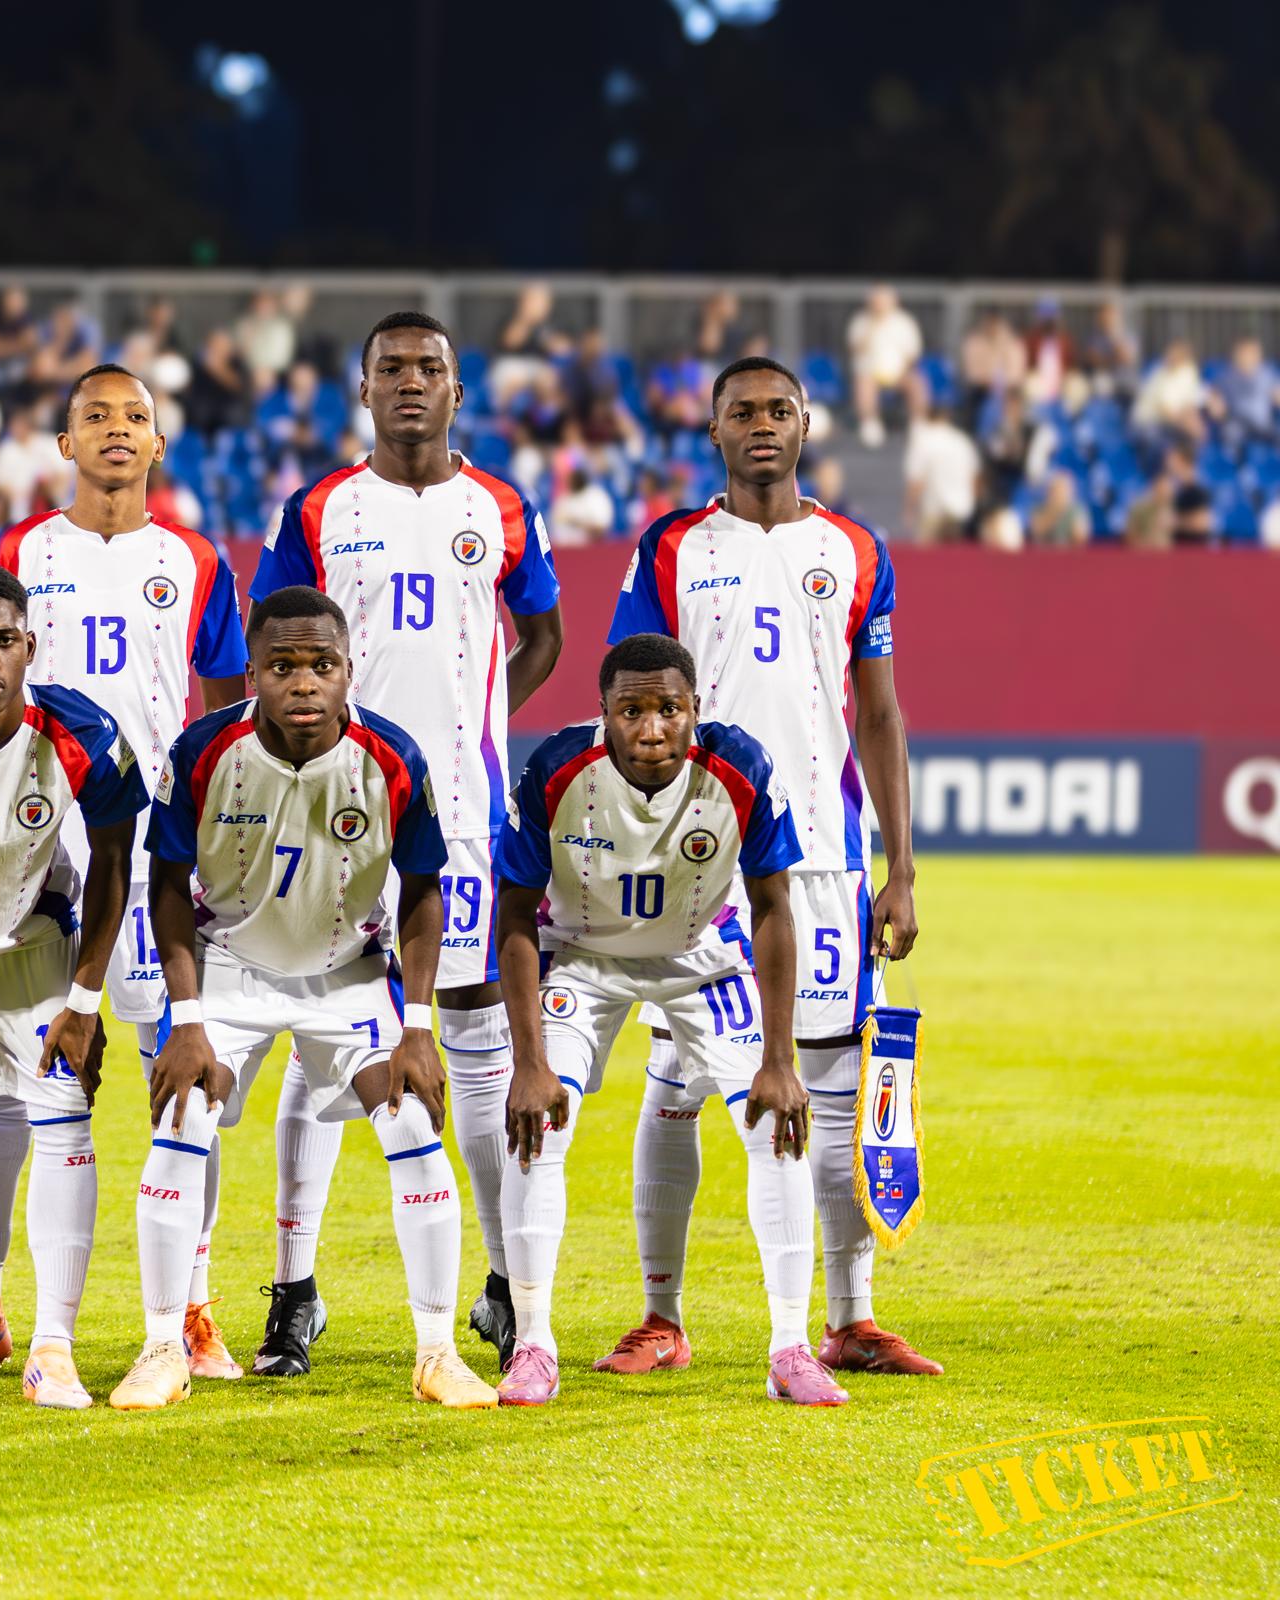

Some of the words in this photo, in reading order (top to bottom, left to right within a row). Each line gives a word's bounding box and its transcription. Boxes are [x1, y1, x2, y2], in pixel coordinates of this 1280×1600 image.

[330, 541, 385, 555] SAETA
[27, 583, 77, 597] SAETA
[686, 577, 741, 593] SAETA
[389, 572, 435, 631] 19
[82, 616, 126, 675] 13
[753, 606, 781, 663] 5
[213, 814, 267, 825] SAETA
[557, 835, 615, 852] SAETA
[274, 844, 304, 898] 7
[441, 876, 482, 934] 19
[617, 872, 665, 920] 10
[814, 927, 842, 985] 5
[697, 973, 754, 1037] 10
[795, 990, 849, 1002] SAETA
[350, 1017, 379, 1049] 7
[140, 1183, 181, 1202] SAETA
[400, 1190, 450, 1205] SAETA
